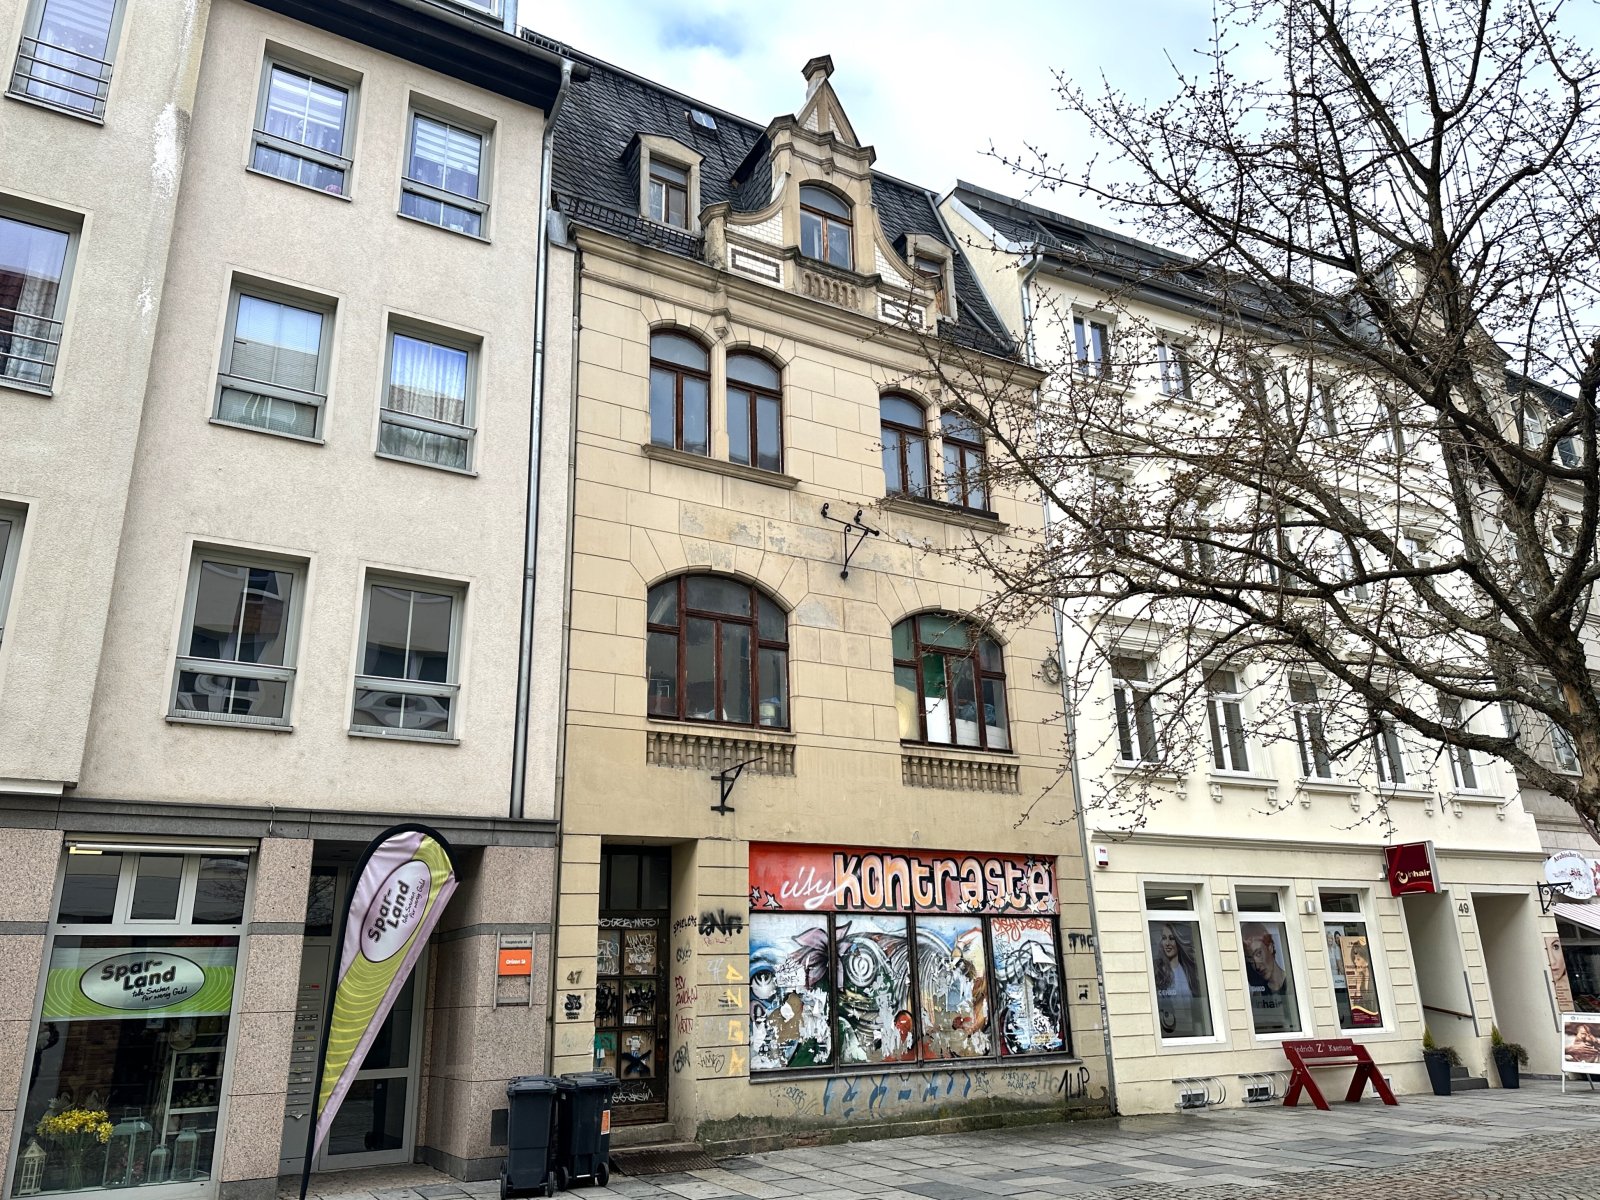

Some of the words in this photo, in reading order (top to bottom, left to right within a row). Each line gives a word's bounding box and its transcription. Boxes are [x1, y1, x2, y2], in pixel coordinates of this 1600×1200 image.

[416, 878, 426, 893] Geld
[368, 888, 392, 944] Spar-
[386, 880, 410, 930] Land
[1458, 902, 1470, 914] 49
[101, 960, 163, 982] Spar-
[123, 966, 177, 991] Land
[566, 970, 582, 985] 47
[172, 986, 188, 997] Geld
[1057, 1066, 1091, 1102] 1UP
